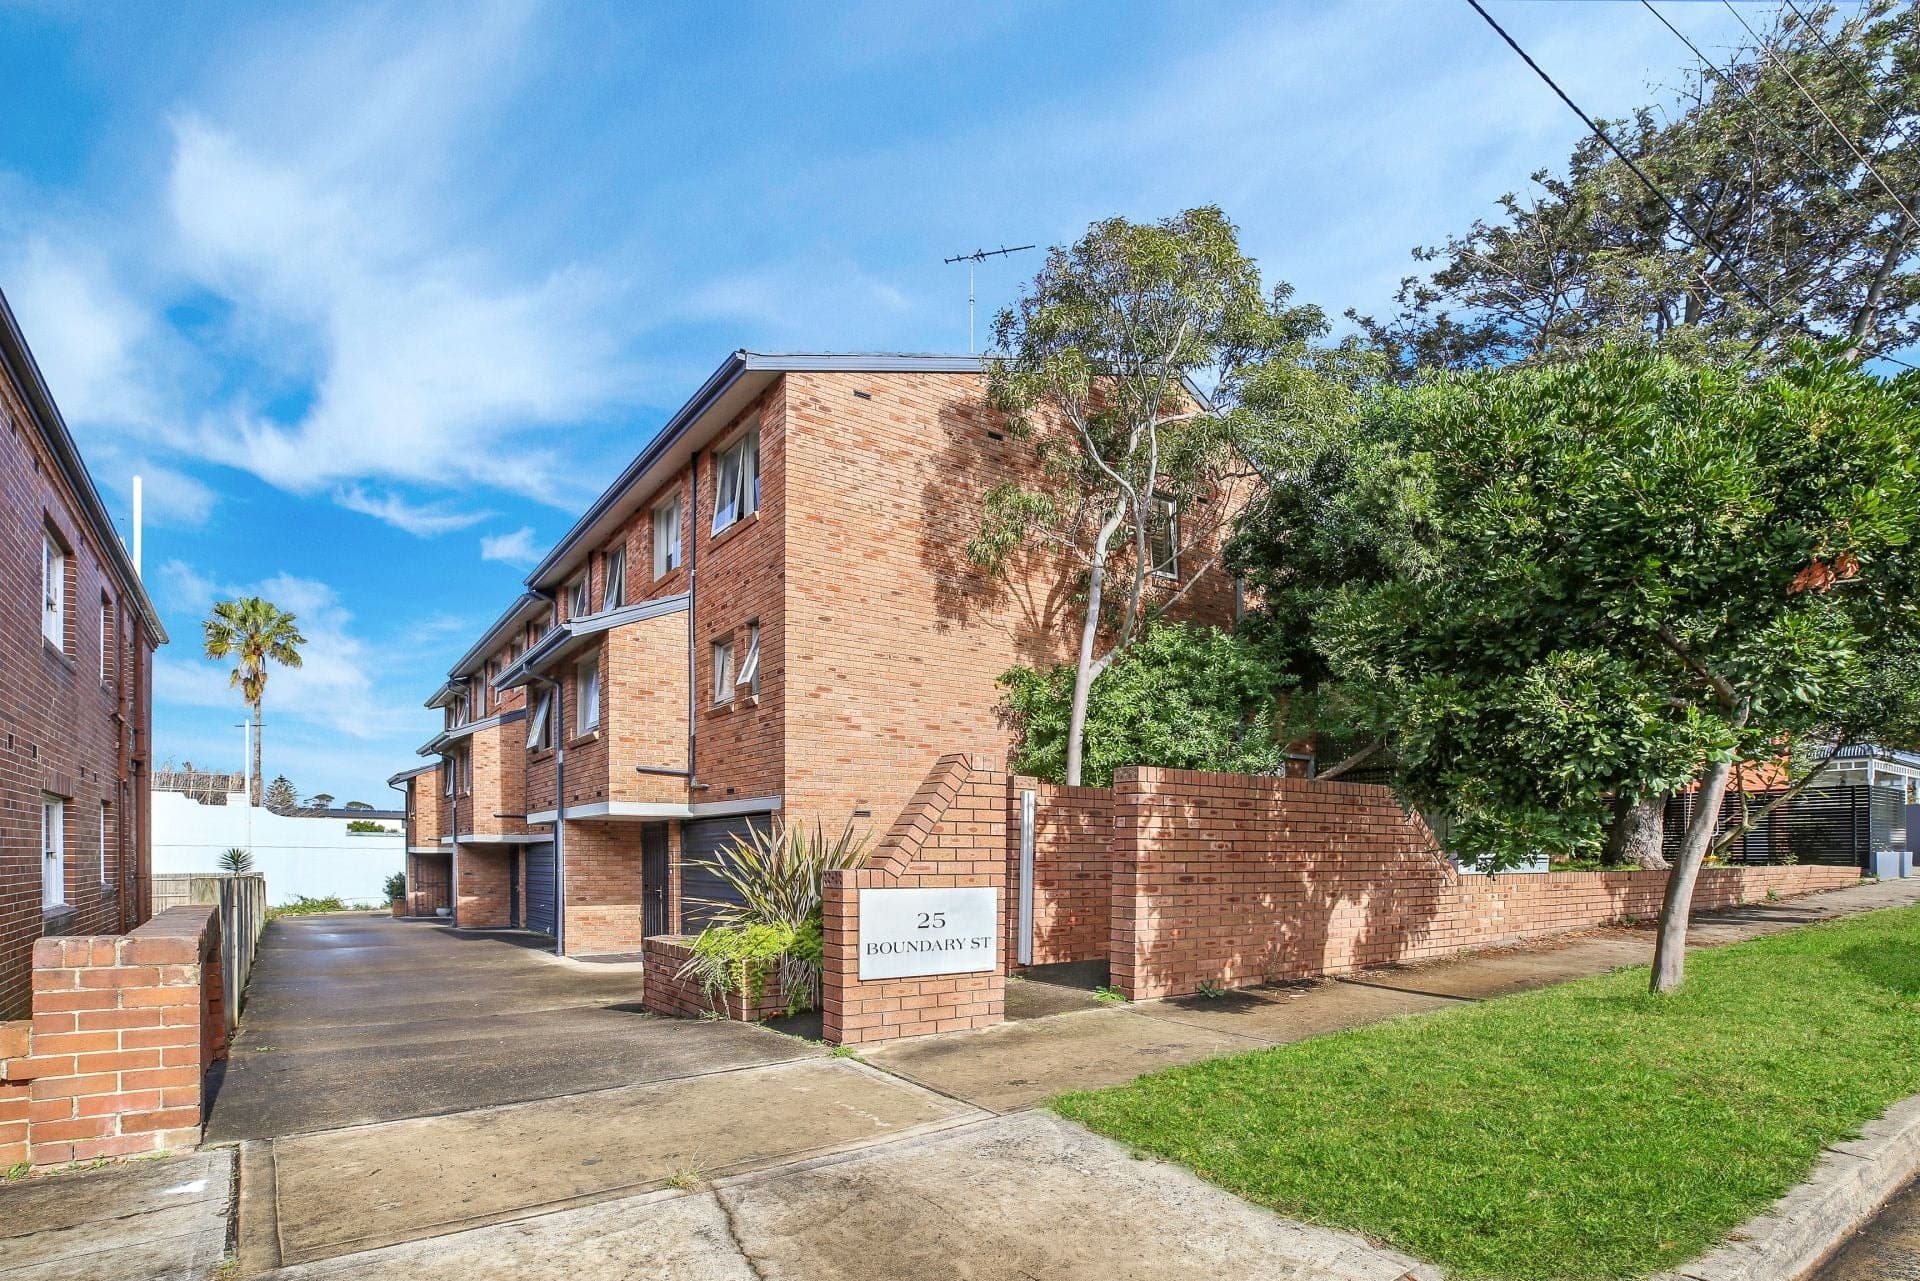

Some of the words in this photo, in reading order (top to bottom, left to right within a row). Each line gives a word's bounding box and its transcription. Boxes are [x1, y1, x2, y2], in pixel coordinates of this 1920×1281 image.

[917, 912, 946, 929] 25
[866, 938, 966, 955] BOUNDARY
[971, 936, 992, 950] ST
